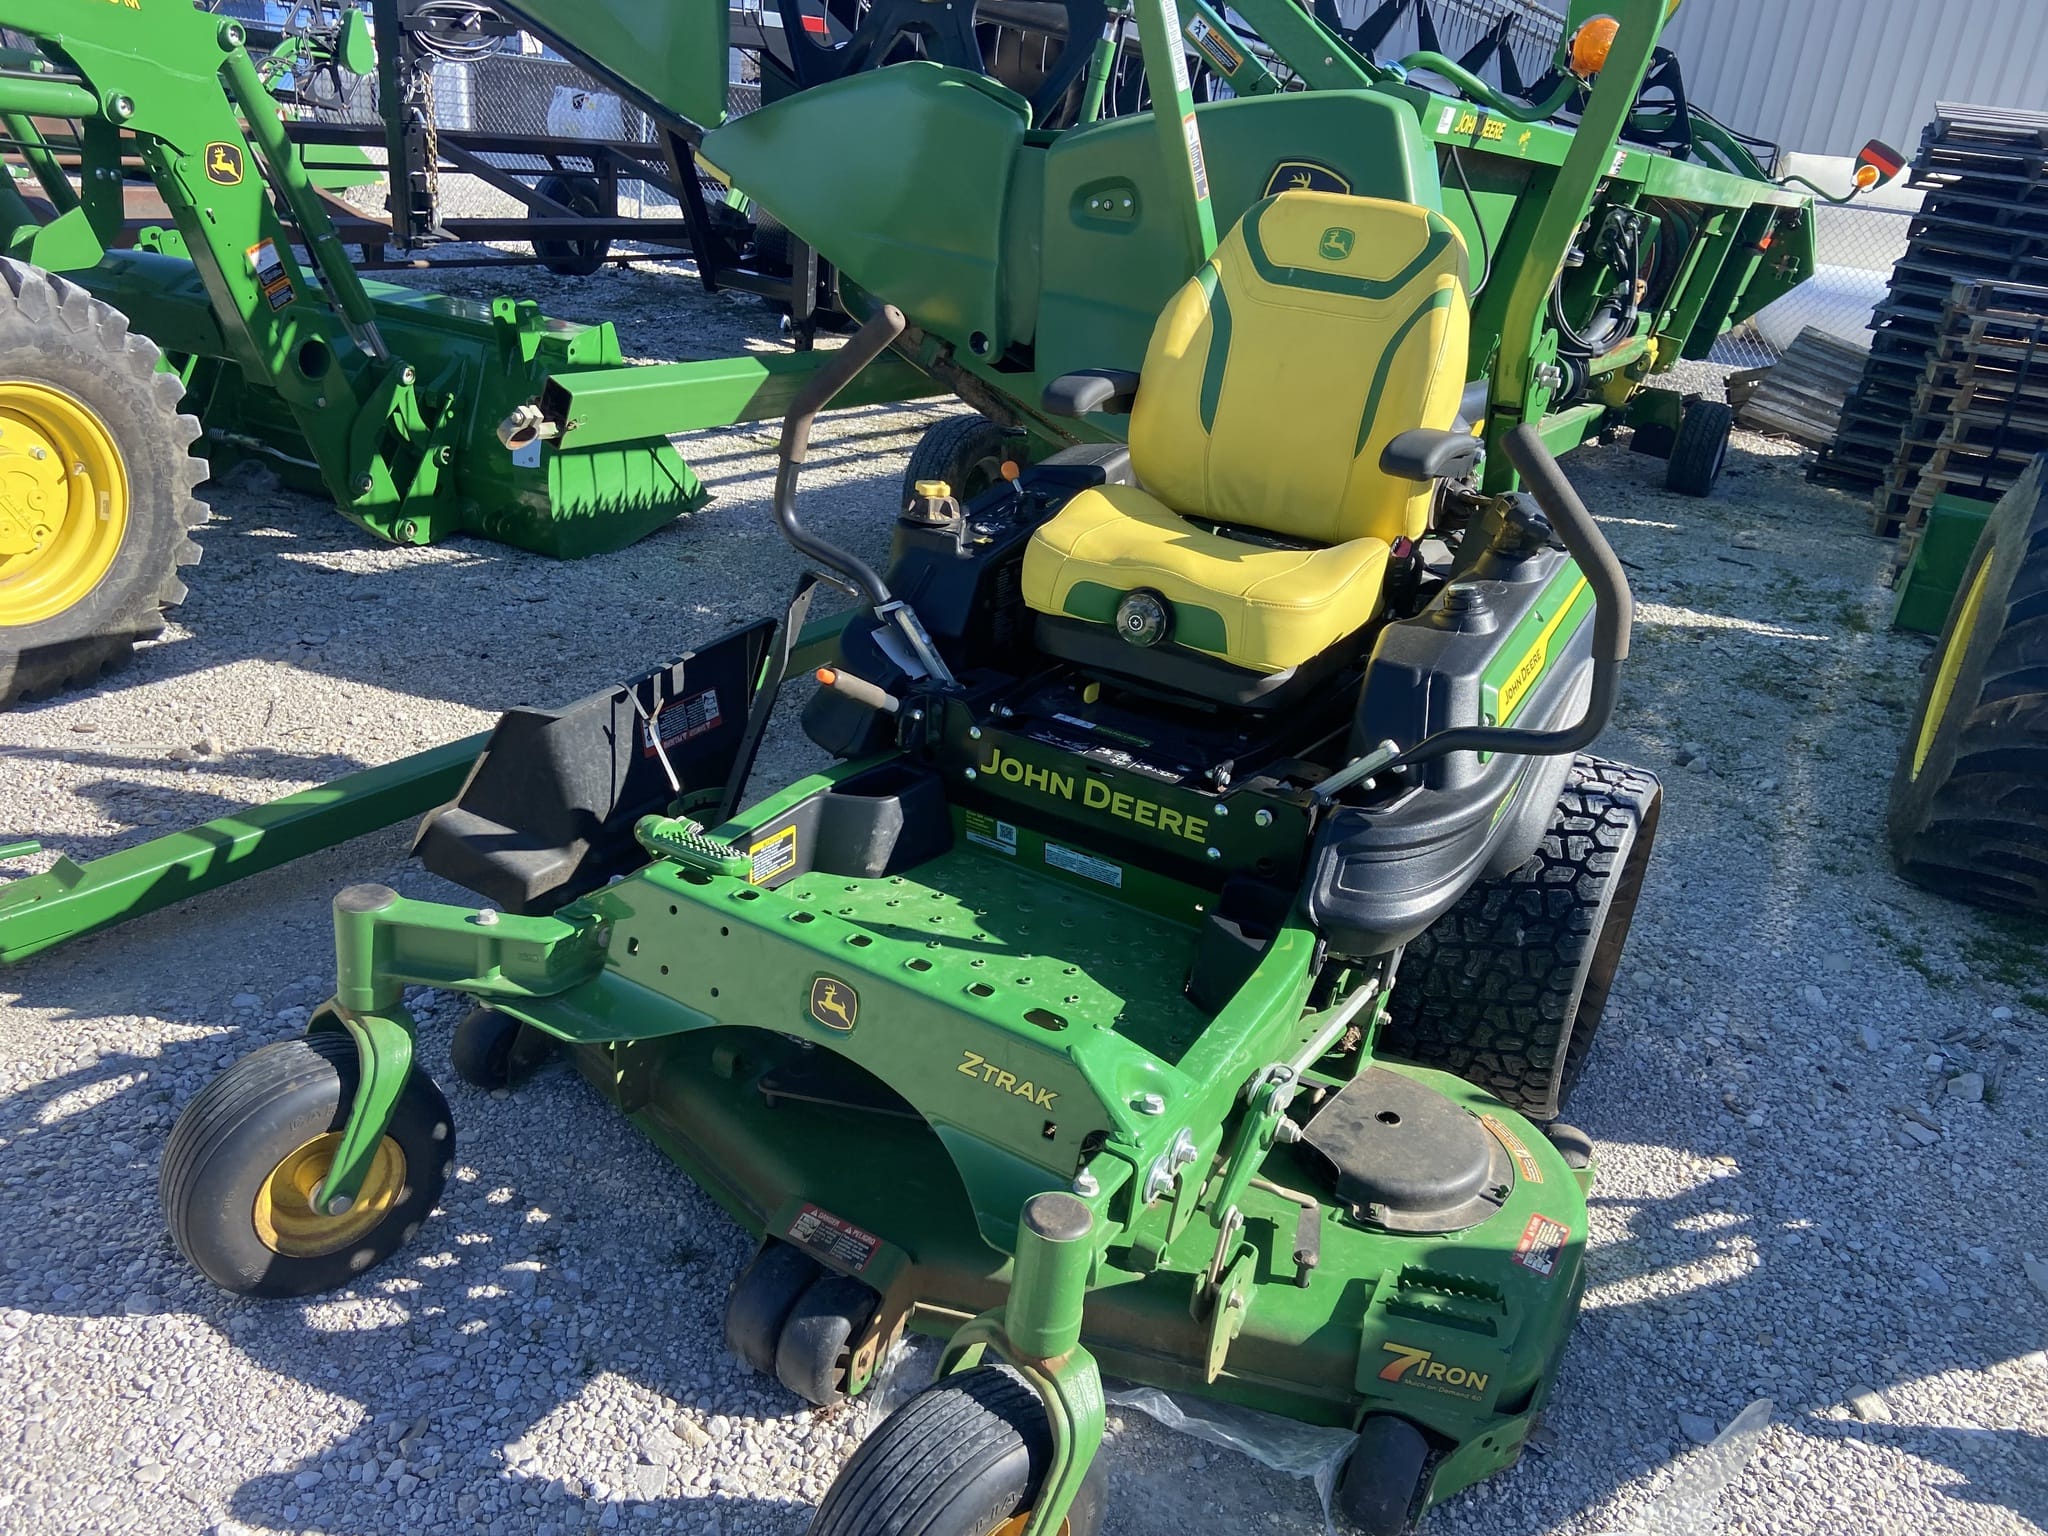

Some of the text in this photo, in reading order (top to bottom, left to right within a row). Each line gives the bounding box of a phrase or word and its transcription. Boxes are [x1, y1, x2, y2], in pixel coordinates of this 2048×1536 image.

[1454, 110, 1478, 135] JOH
[1481, 117, 1507, 141] EERE
[1505, 648, 1542, 705] JOHN DEERE
[980, 748, 1209, 844] JOHN DEERE
[957, 1050, 1059, 1111] ZTRAK
[1404, 1378, 1426, 1389] Mulch
[1438, 1386, 1470, 1399] Demand
